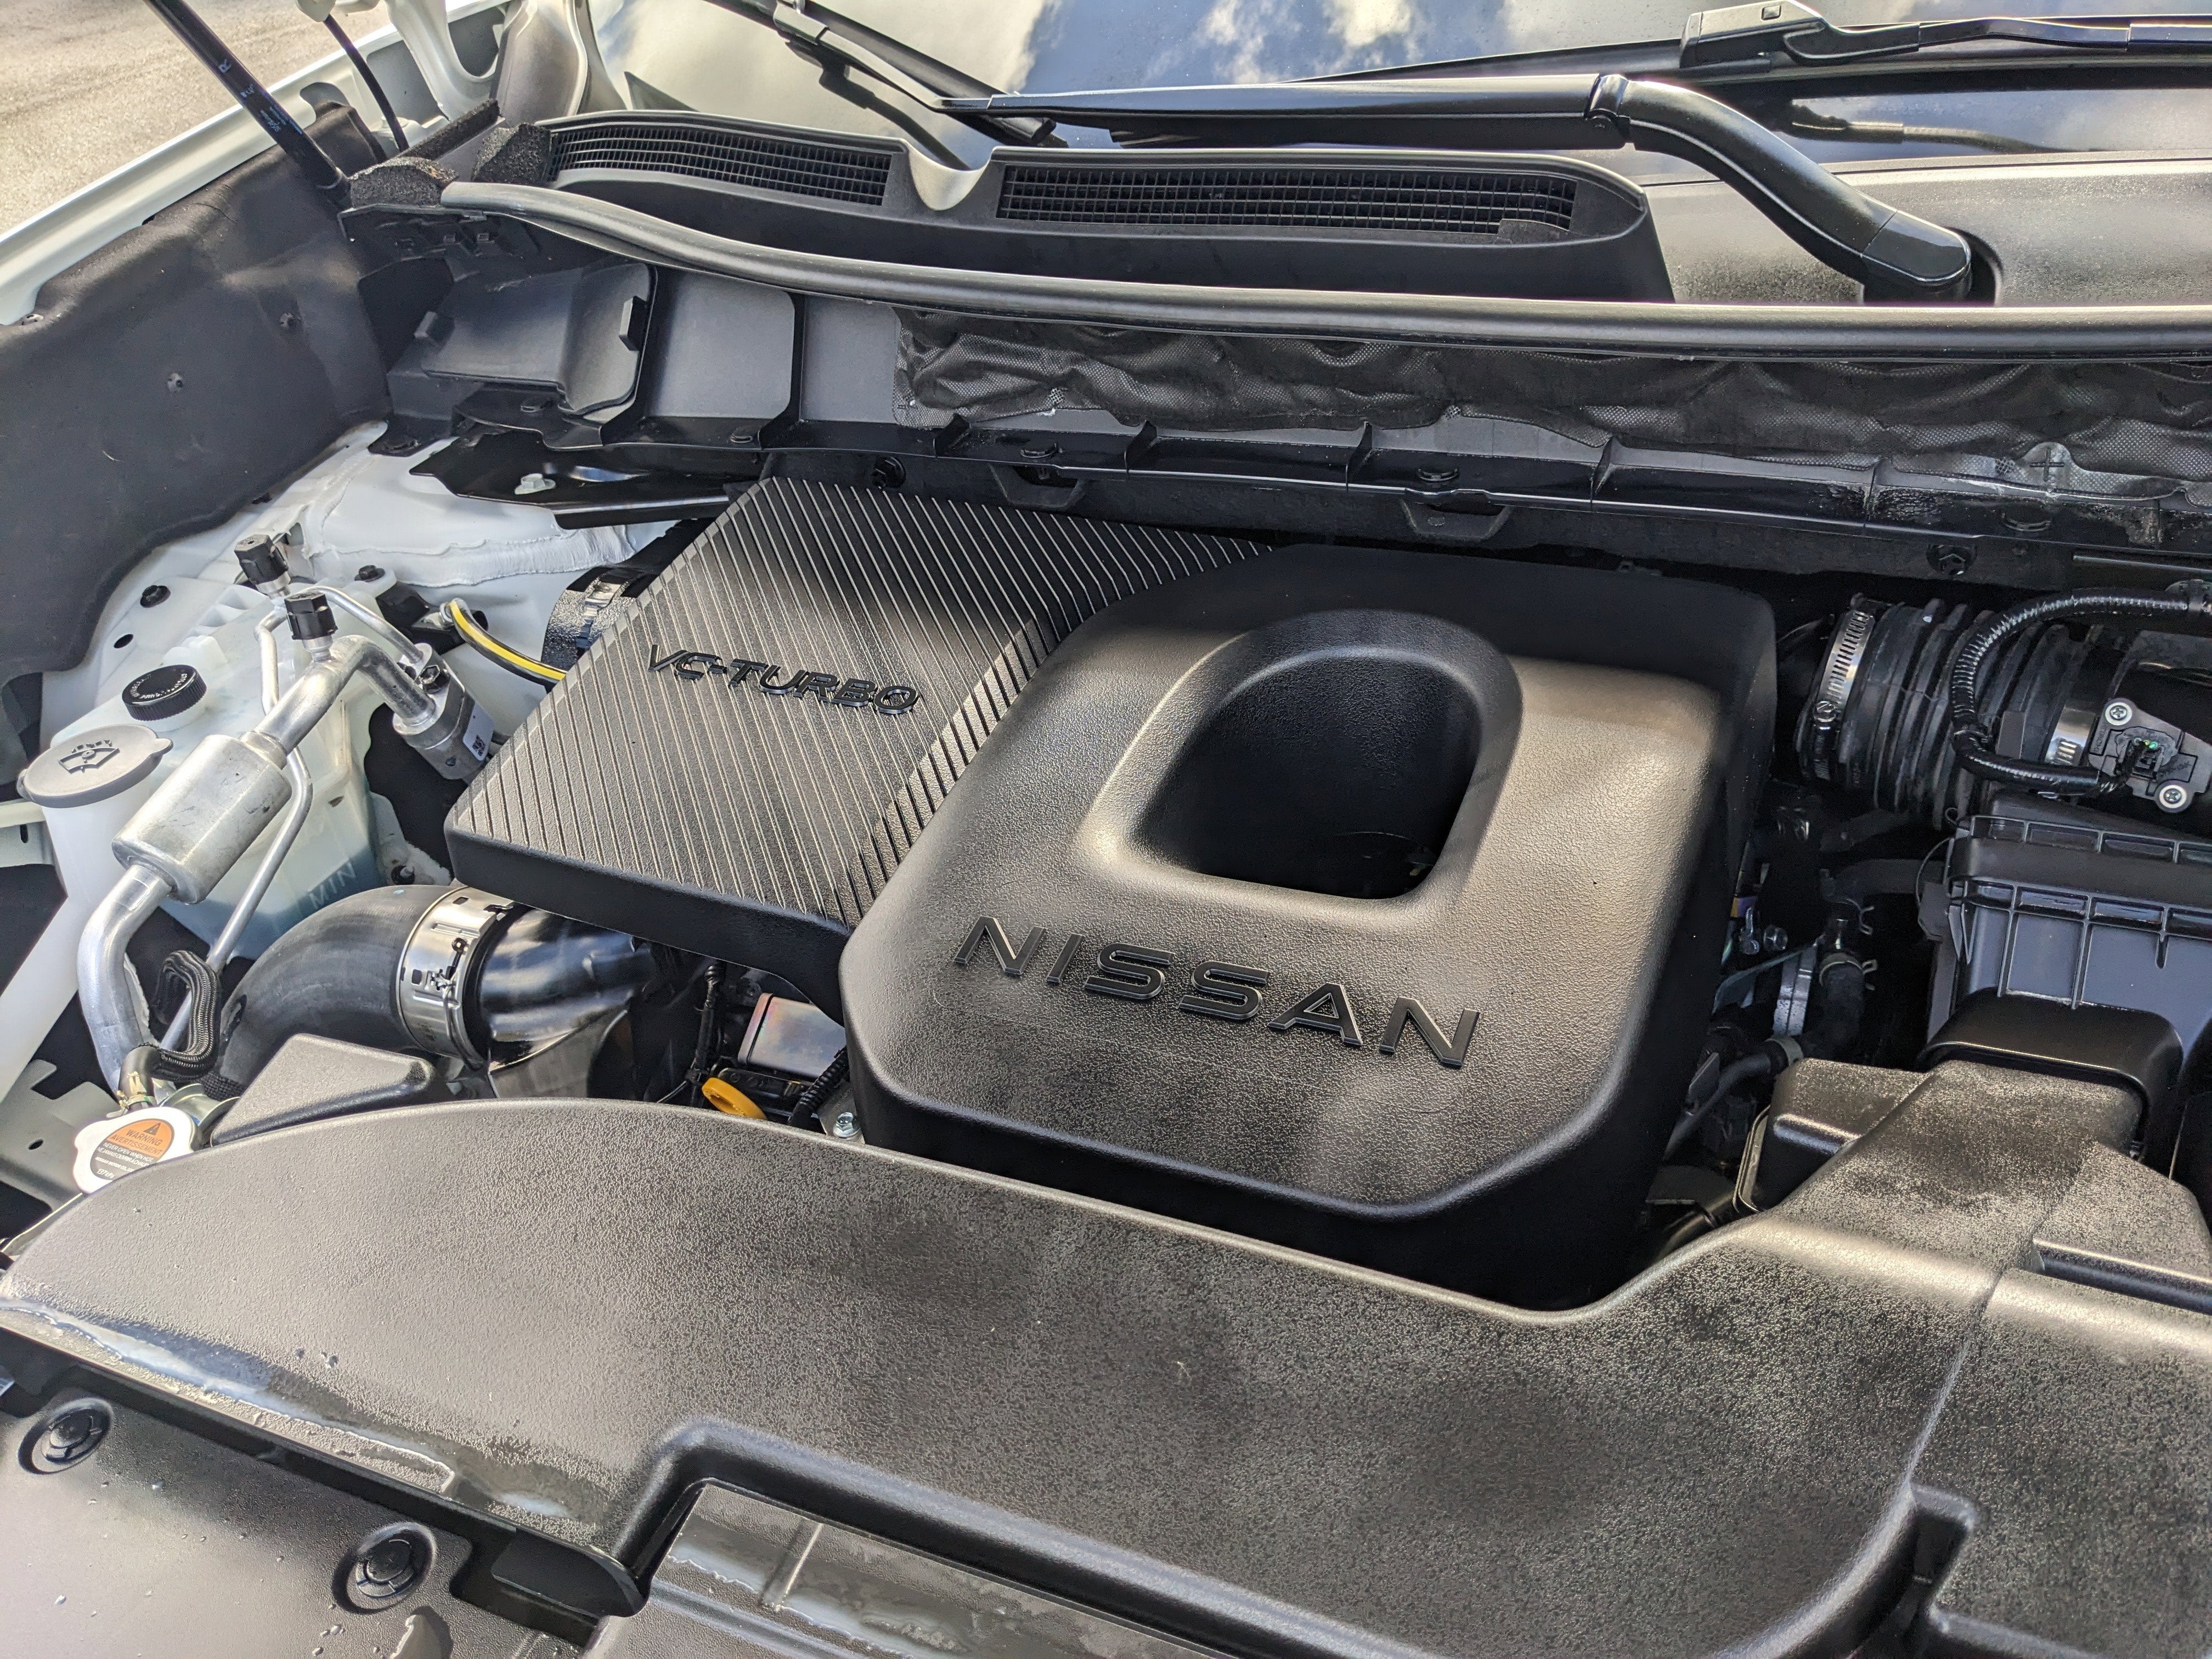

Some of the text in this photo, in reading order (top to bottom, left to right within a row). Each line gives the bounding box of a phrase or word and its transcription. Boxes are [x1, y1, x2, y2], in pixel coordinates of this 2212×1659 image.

[647, 643, 919, 715] VC-TURBO
[308, 860, 357, 910] MIN
[953, 915, 1480, 1069] NISSAN
[103, 1142, 119, 1150] NEVER
[129, 1151, 144, 1159] WHEN
[110, 1134, 163, 1156] AVERTISSEMENT
[126, 1128, 163, 1147] WARNING
